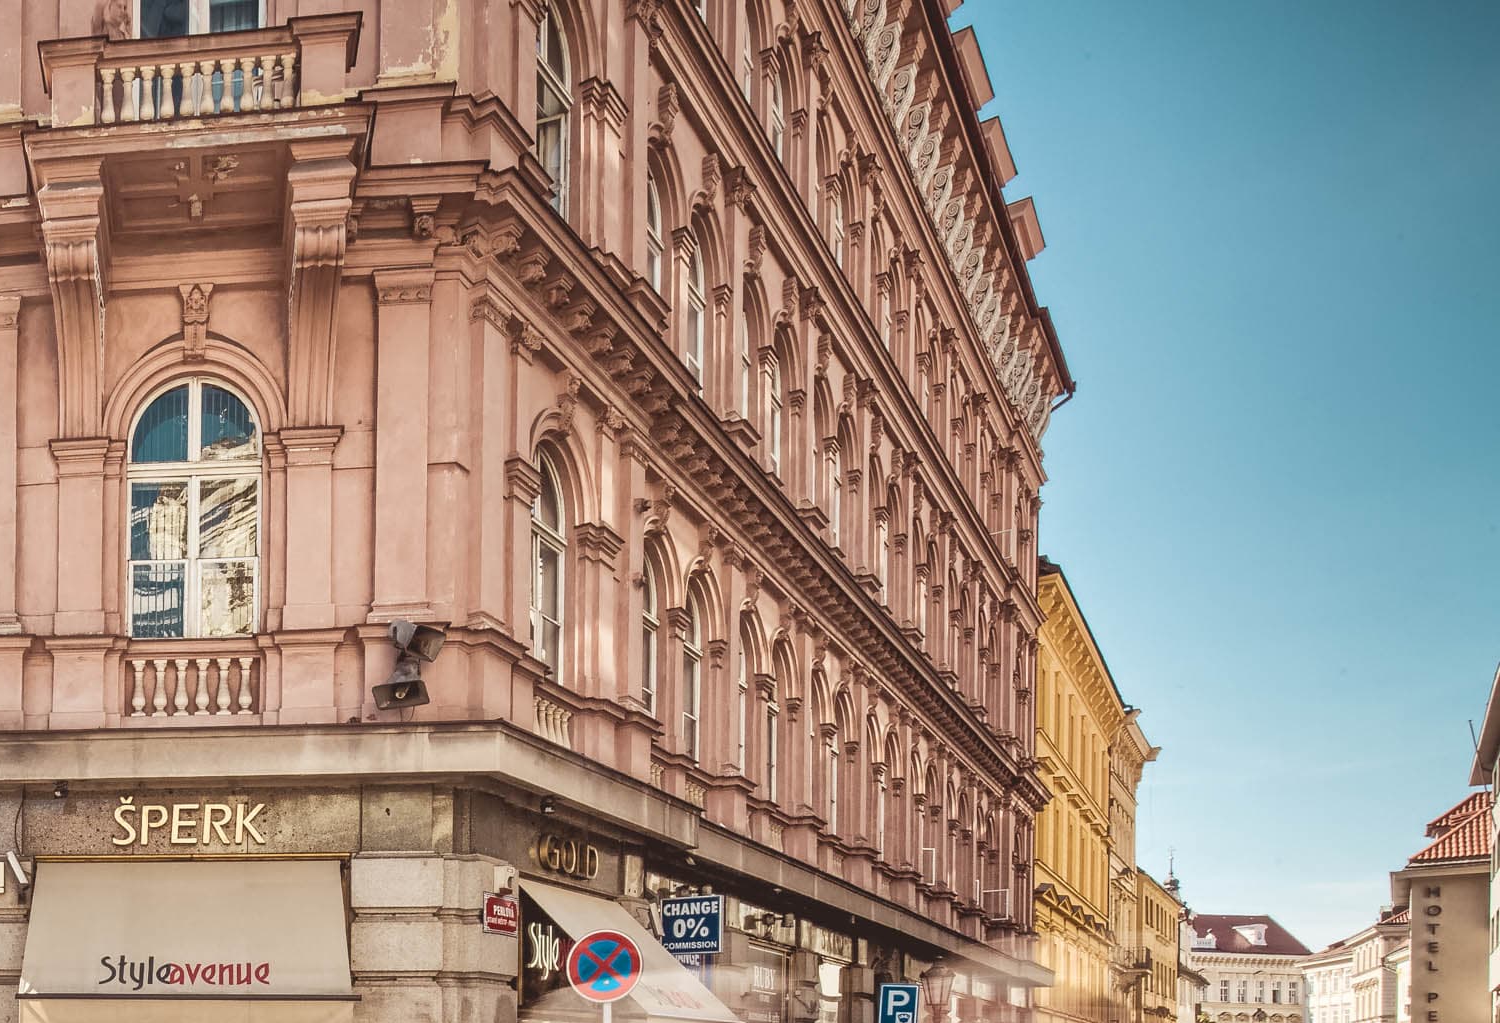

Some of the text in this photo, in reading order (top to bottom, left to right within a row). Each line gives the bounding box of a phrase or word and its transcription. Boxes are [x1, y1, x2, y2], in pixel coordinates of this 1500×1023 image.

[112, 796, 266, 846] ŠPERK
[543, 834, 599, 879] GOLD
[663, 901, 718, 916] CHANGE
[673, 917, 709, 938] 0%
[1425, 886, 1442, 972] HOTEL
[663, 940, 717, 950] COMMISSION
[753, 965, 776, 990] RUBY
[886, 989, 910, 1016] P
